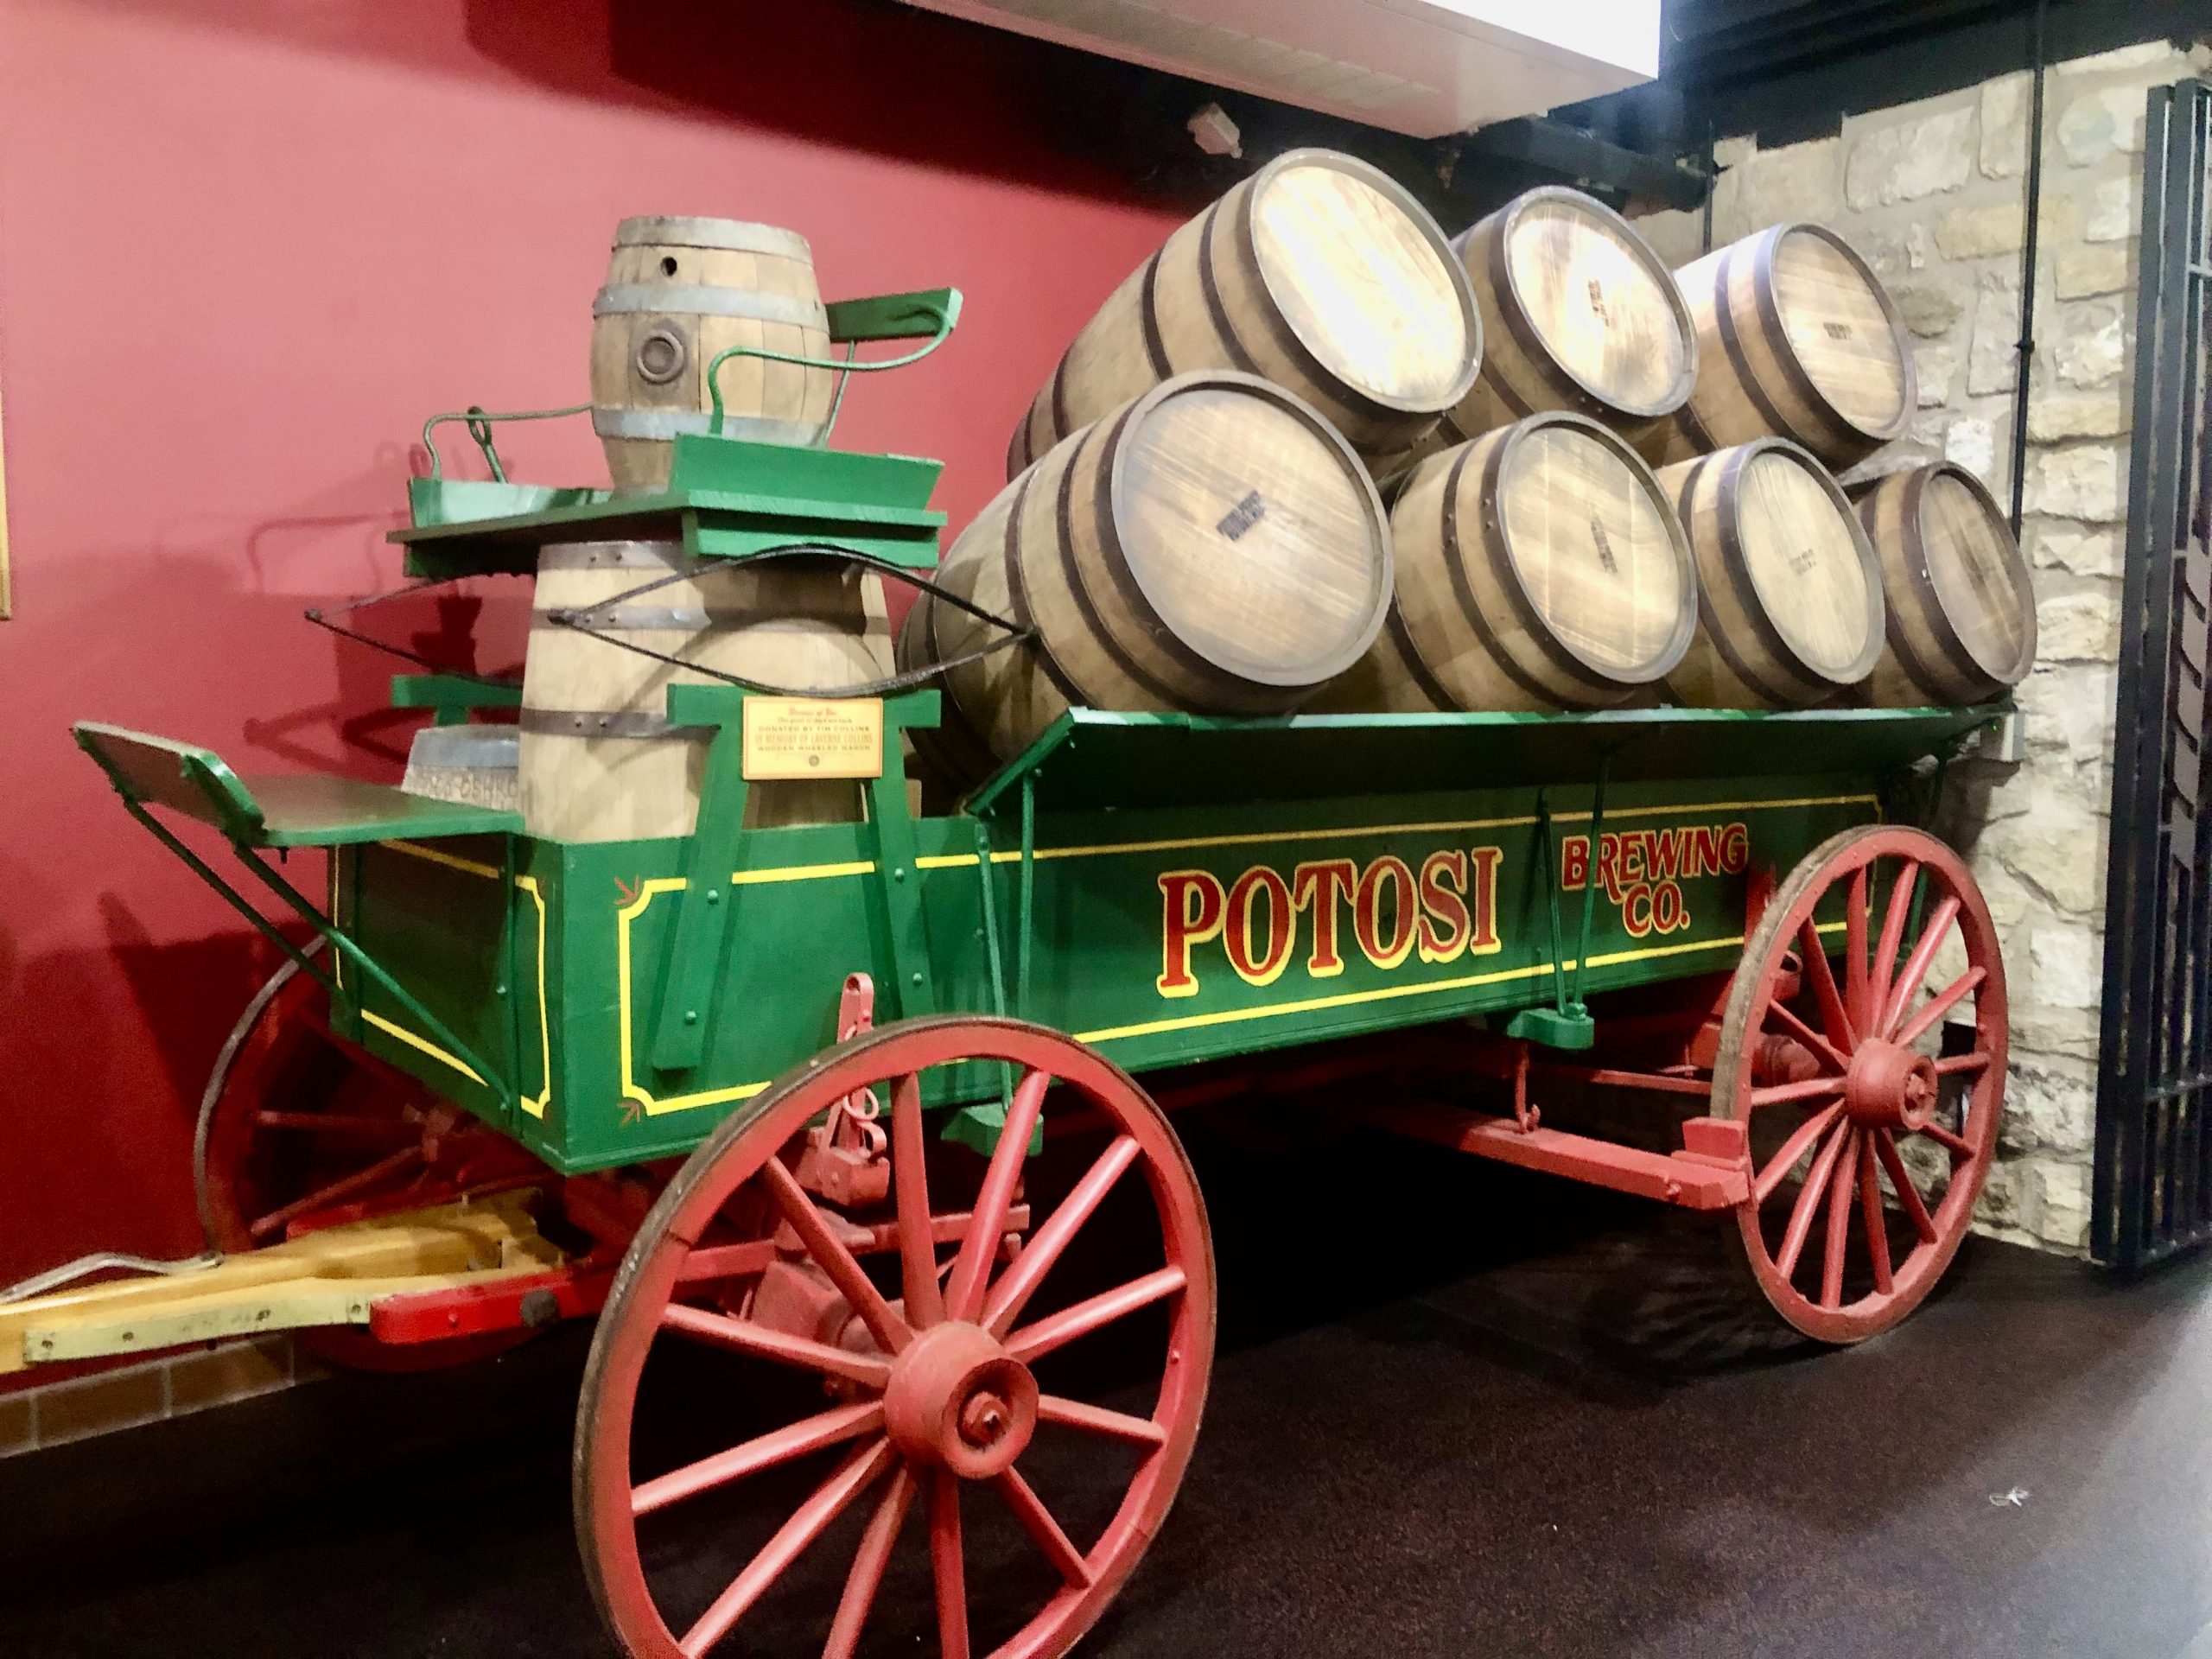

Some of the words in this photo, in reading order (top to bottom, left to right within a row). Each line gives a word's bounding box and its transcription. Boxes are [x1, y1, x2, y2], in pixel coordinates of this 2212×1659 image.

[766, 734, 797, 744] MEMORY
[843, 734, 873, 744] COLLINS
[1561, 823, 1749, 905] BREWING
[1156, 846, 1503, 998] POTOSI
[1622, 880, 1690, 938] CO.
